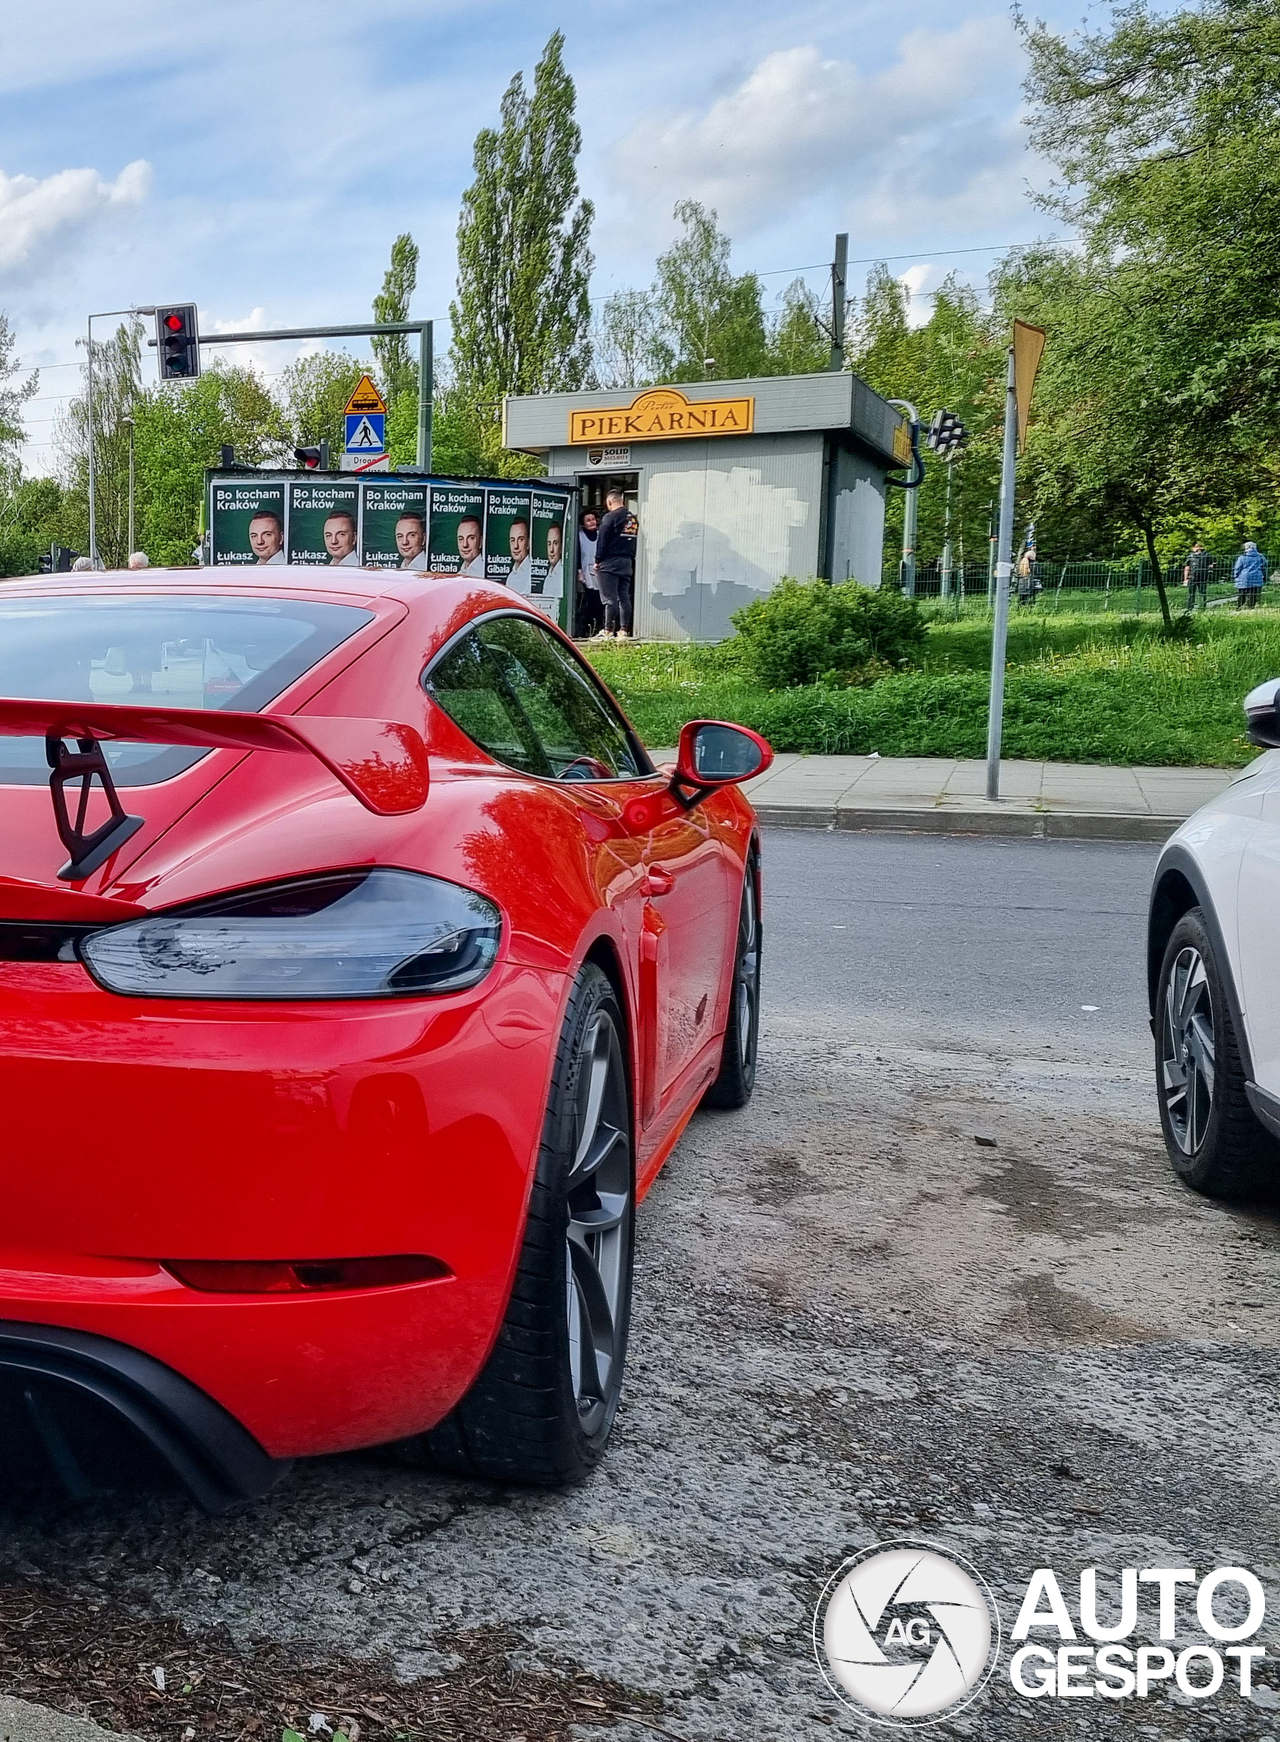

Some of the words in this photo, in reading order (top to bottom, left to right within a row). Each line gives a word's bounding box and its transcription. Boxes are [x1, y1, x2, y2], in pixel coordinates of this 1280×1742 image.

[580, 408, 739, 436] PIEKARNIA
[604, 448, 628, 456] SOLID
[217, 490, 232, 500] Bo
[236, 490, 280, 499] kocham
[293, 489, 310, 499] Bo
[312, 489, 355, 499] kocham
[366, 490, 381, 500] Bo
[384, 490, 423, 500] kocham
[433, 493, 446, 502] Bo
[448, 493, 482, 503] kocham
[217, 500, 259, 510] Kraków
[293, 499, 335, 509] Kraków
[366, 500, 405, 510] Kraków
[489, 495, 501, 504] Bo
[502, 495, 529, 505] kocham
[534, 498, 542, 508] Bo
[543, 499, 564, 510] kocham
[432, 502, 467, 513] Kraków
[489, 505, 518, 515] Kraków
[532, 508, 554, 518] Kraków
[217, 551, 253, 560] Łukasz
[291, 550, 327, 559] Łukasz
[365, 551, 399, 560] Łukasz
[430, 553, 460, 562] Łukasz
[487, 554, 511, 563] Łukasz
[430, 563, 458, 573] Gibała
[487, 564, 510, 573] Gibała
